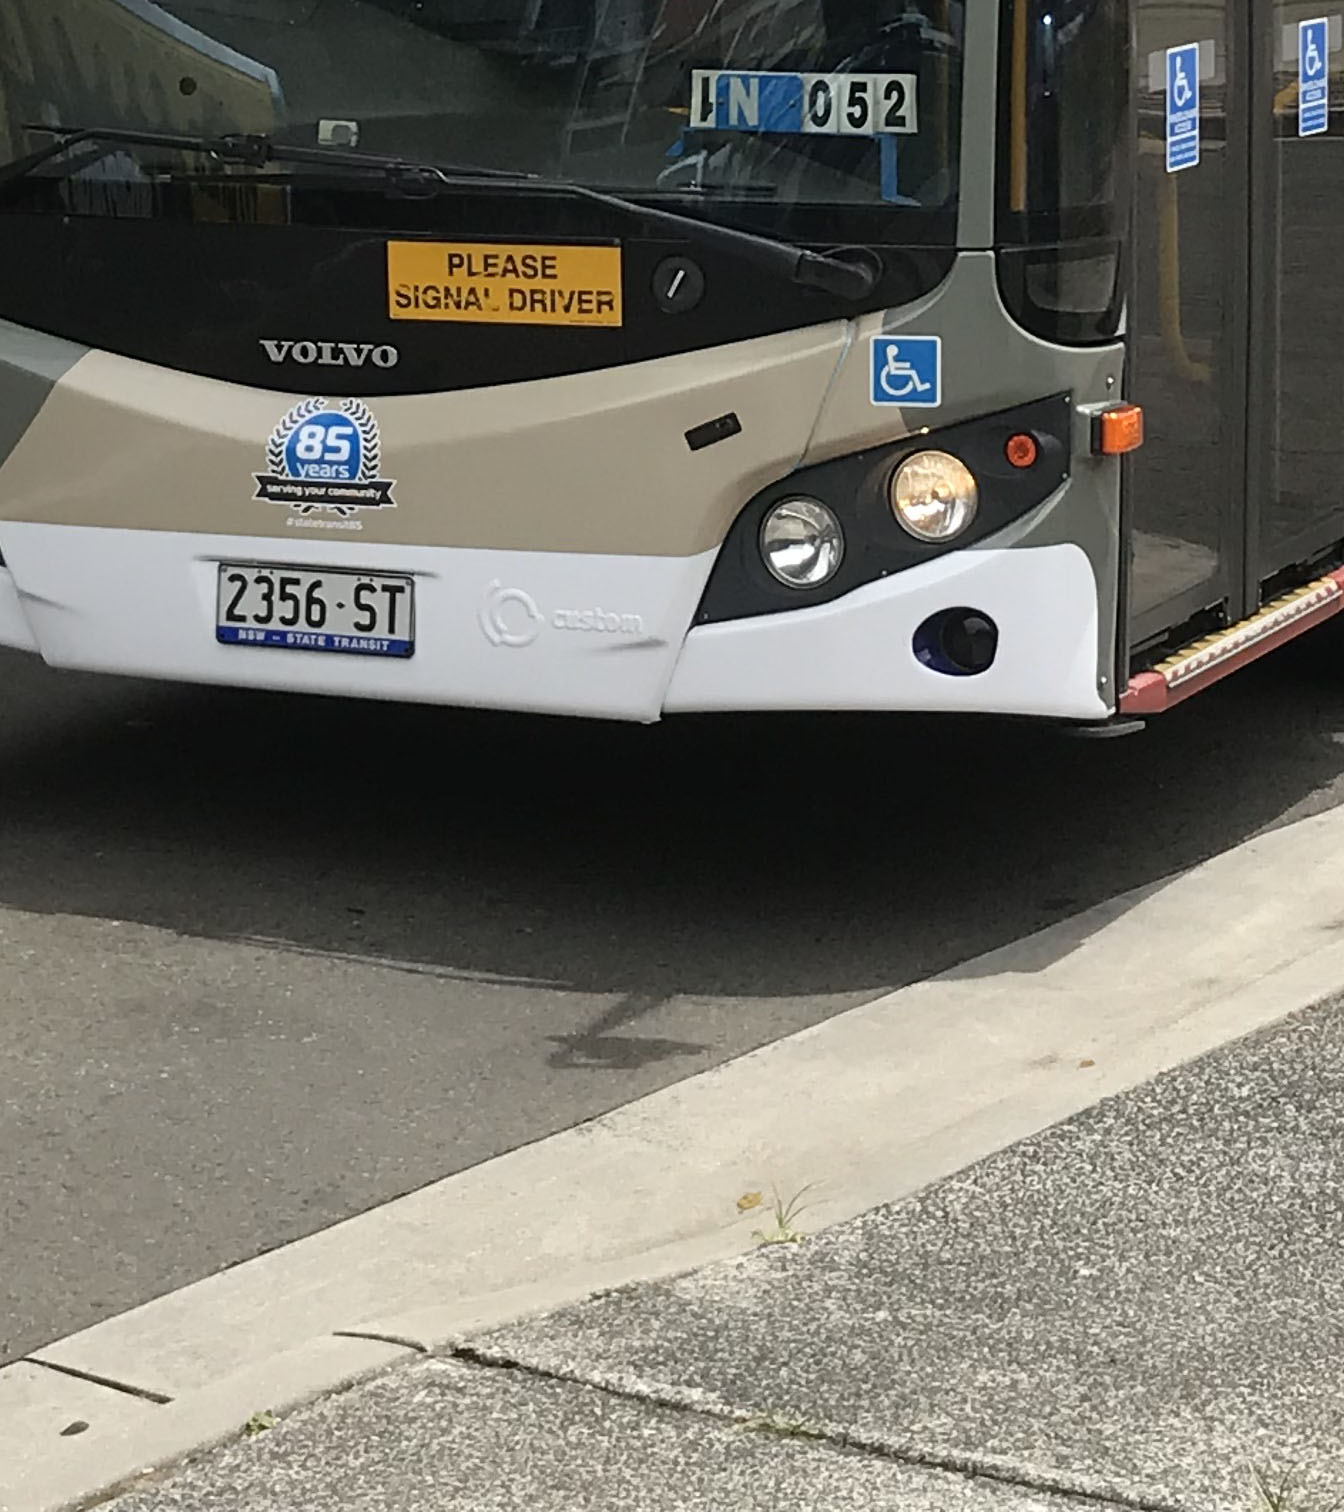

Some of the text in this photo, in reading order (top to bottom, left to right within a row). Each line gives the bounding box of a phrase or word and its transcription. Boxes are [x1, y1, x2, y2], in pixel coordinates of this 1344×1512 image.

[807, 79, 908, 130] 052
[447, 253, 558, 280] PLEASE
[508, 288, 615, 316] DRIVER
[259, 339, 399, 369] VOLVO
[295, 424, 354, 462] 85
[296, 463, 349, 479] years
[266, 484, 382, 501] serving your community
[552, 607, 642, 634] custom
[286, 633, 326, 646] STATE
[333, 637, 390, 652] TRANSIT
